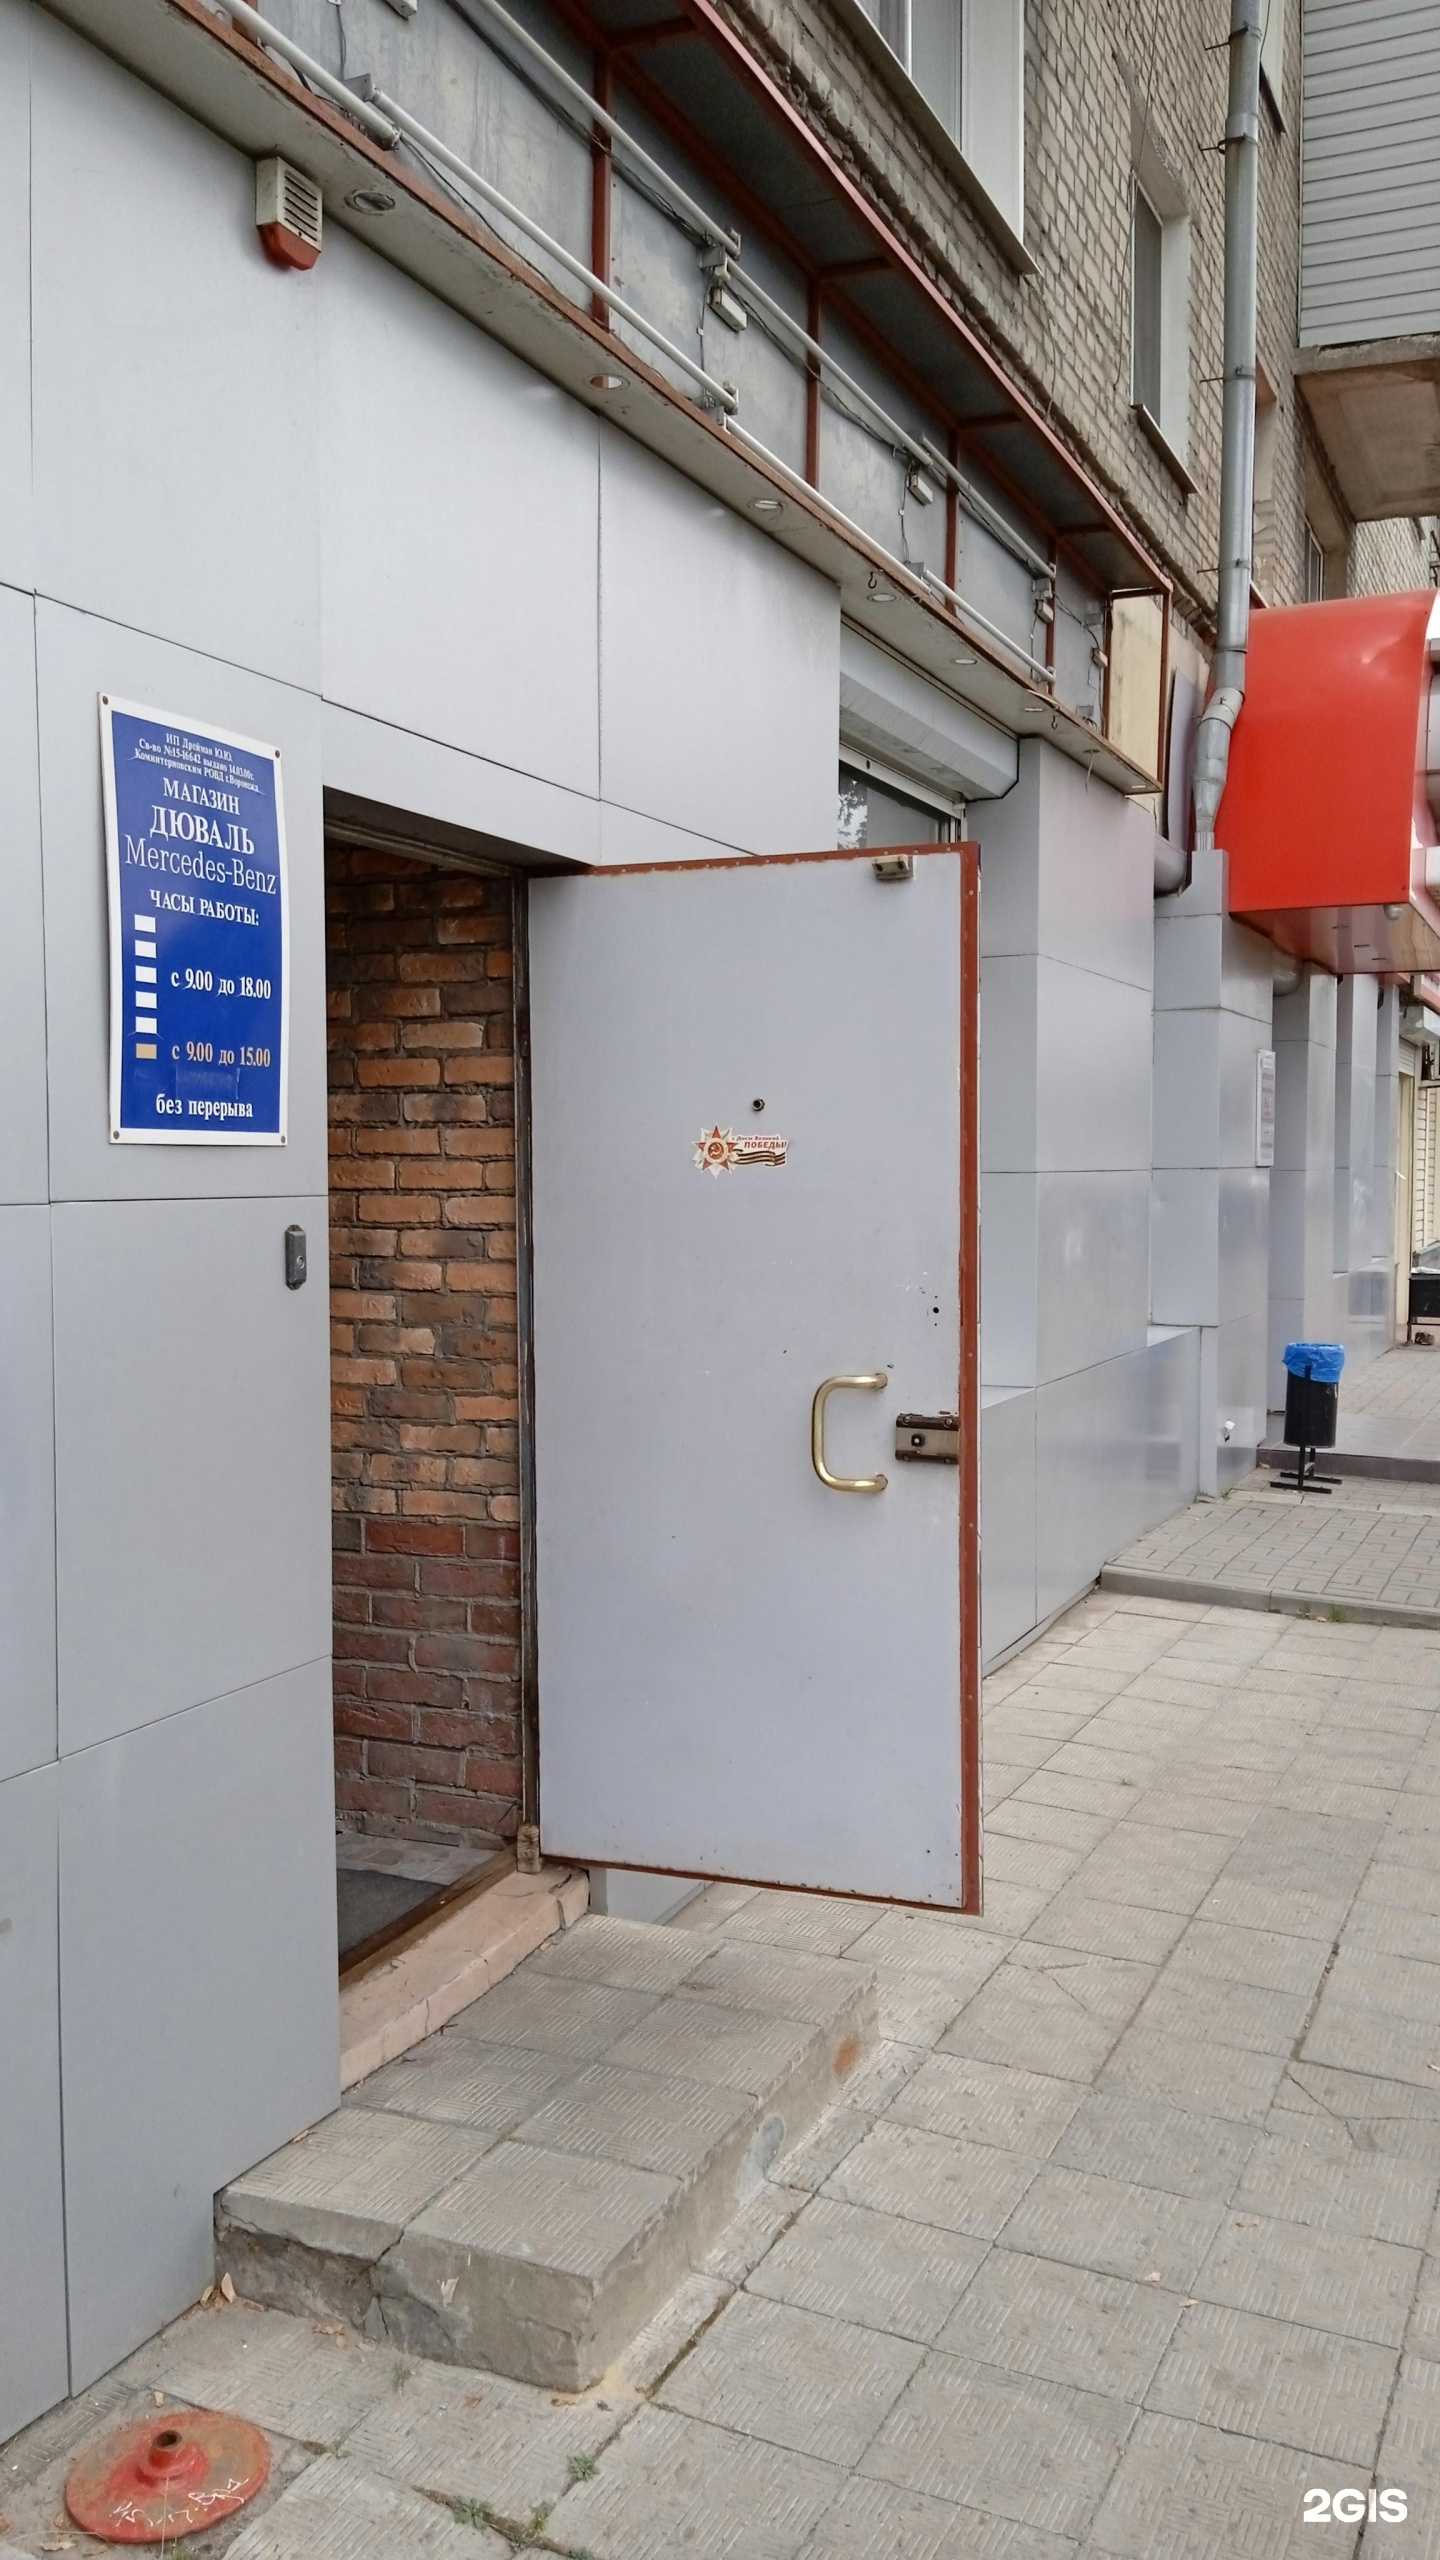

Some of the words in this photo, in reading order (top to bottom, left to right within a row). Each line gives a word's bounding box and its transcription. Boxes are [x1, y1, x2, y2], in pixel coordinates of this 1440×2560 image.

[139, 738, 161, 752] Св-во
[166, 733, 180, 745] ИП
[204, 767, 224, 782] РОВД
[163, 778, 240, 815] МАГАЗИН
[149, 805, 255, 855] ДЮВАЛЬ
[124, 834, 278, 895] Mercedes-Benz
[149, 889, 194, 914] ЧАСЫ
[199, 898, 260, 926] РАБОТЫ:
[171, 971, 180, 987] с
[185, 968, 213, 992] 9.00
[218, 978, 235, 996] до
[239, 976, 272, 999] 18.00
[171, 1044, 180, 1060] с
[186, 1042, 213, 1063] 9.00
[219, 1049, 235, 1065] до
[240, 1046, 271, 1068] 15.00
[155, 1093, 183, 1114] без
[188, 1100, 253, 1121] перерыва
